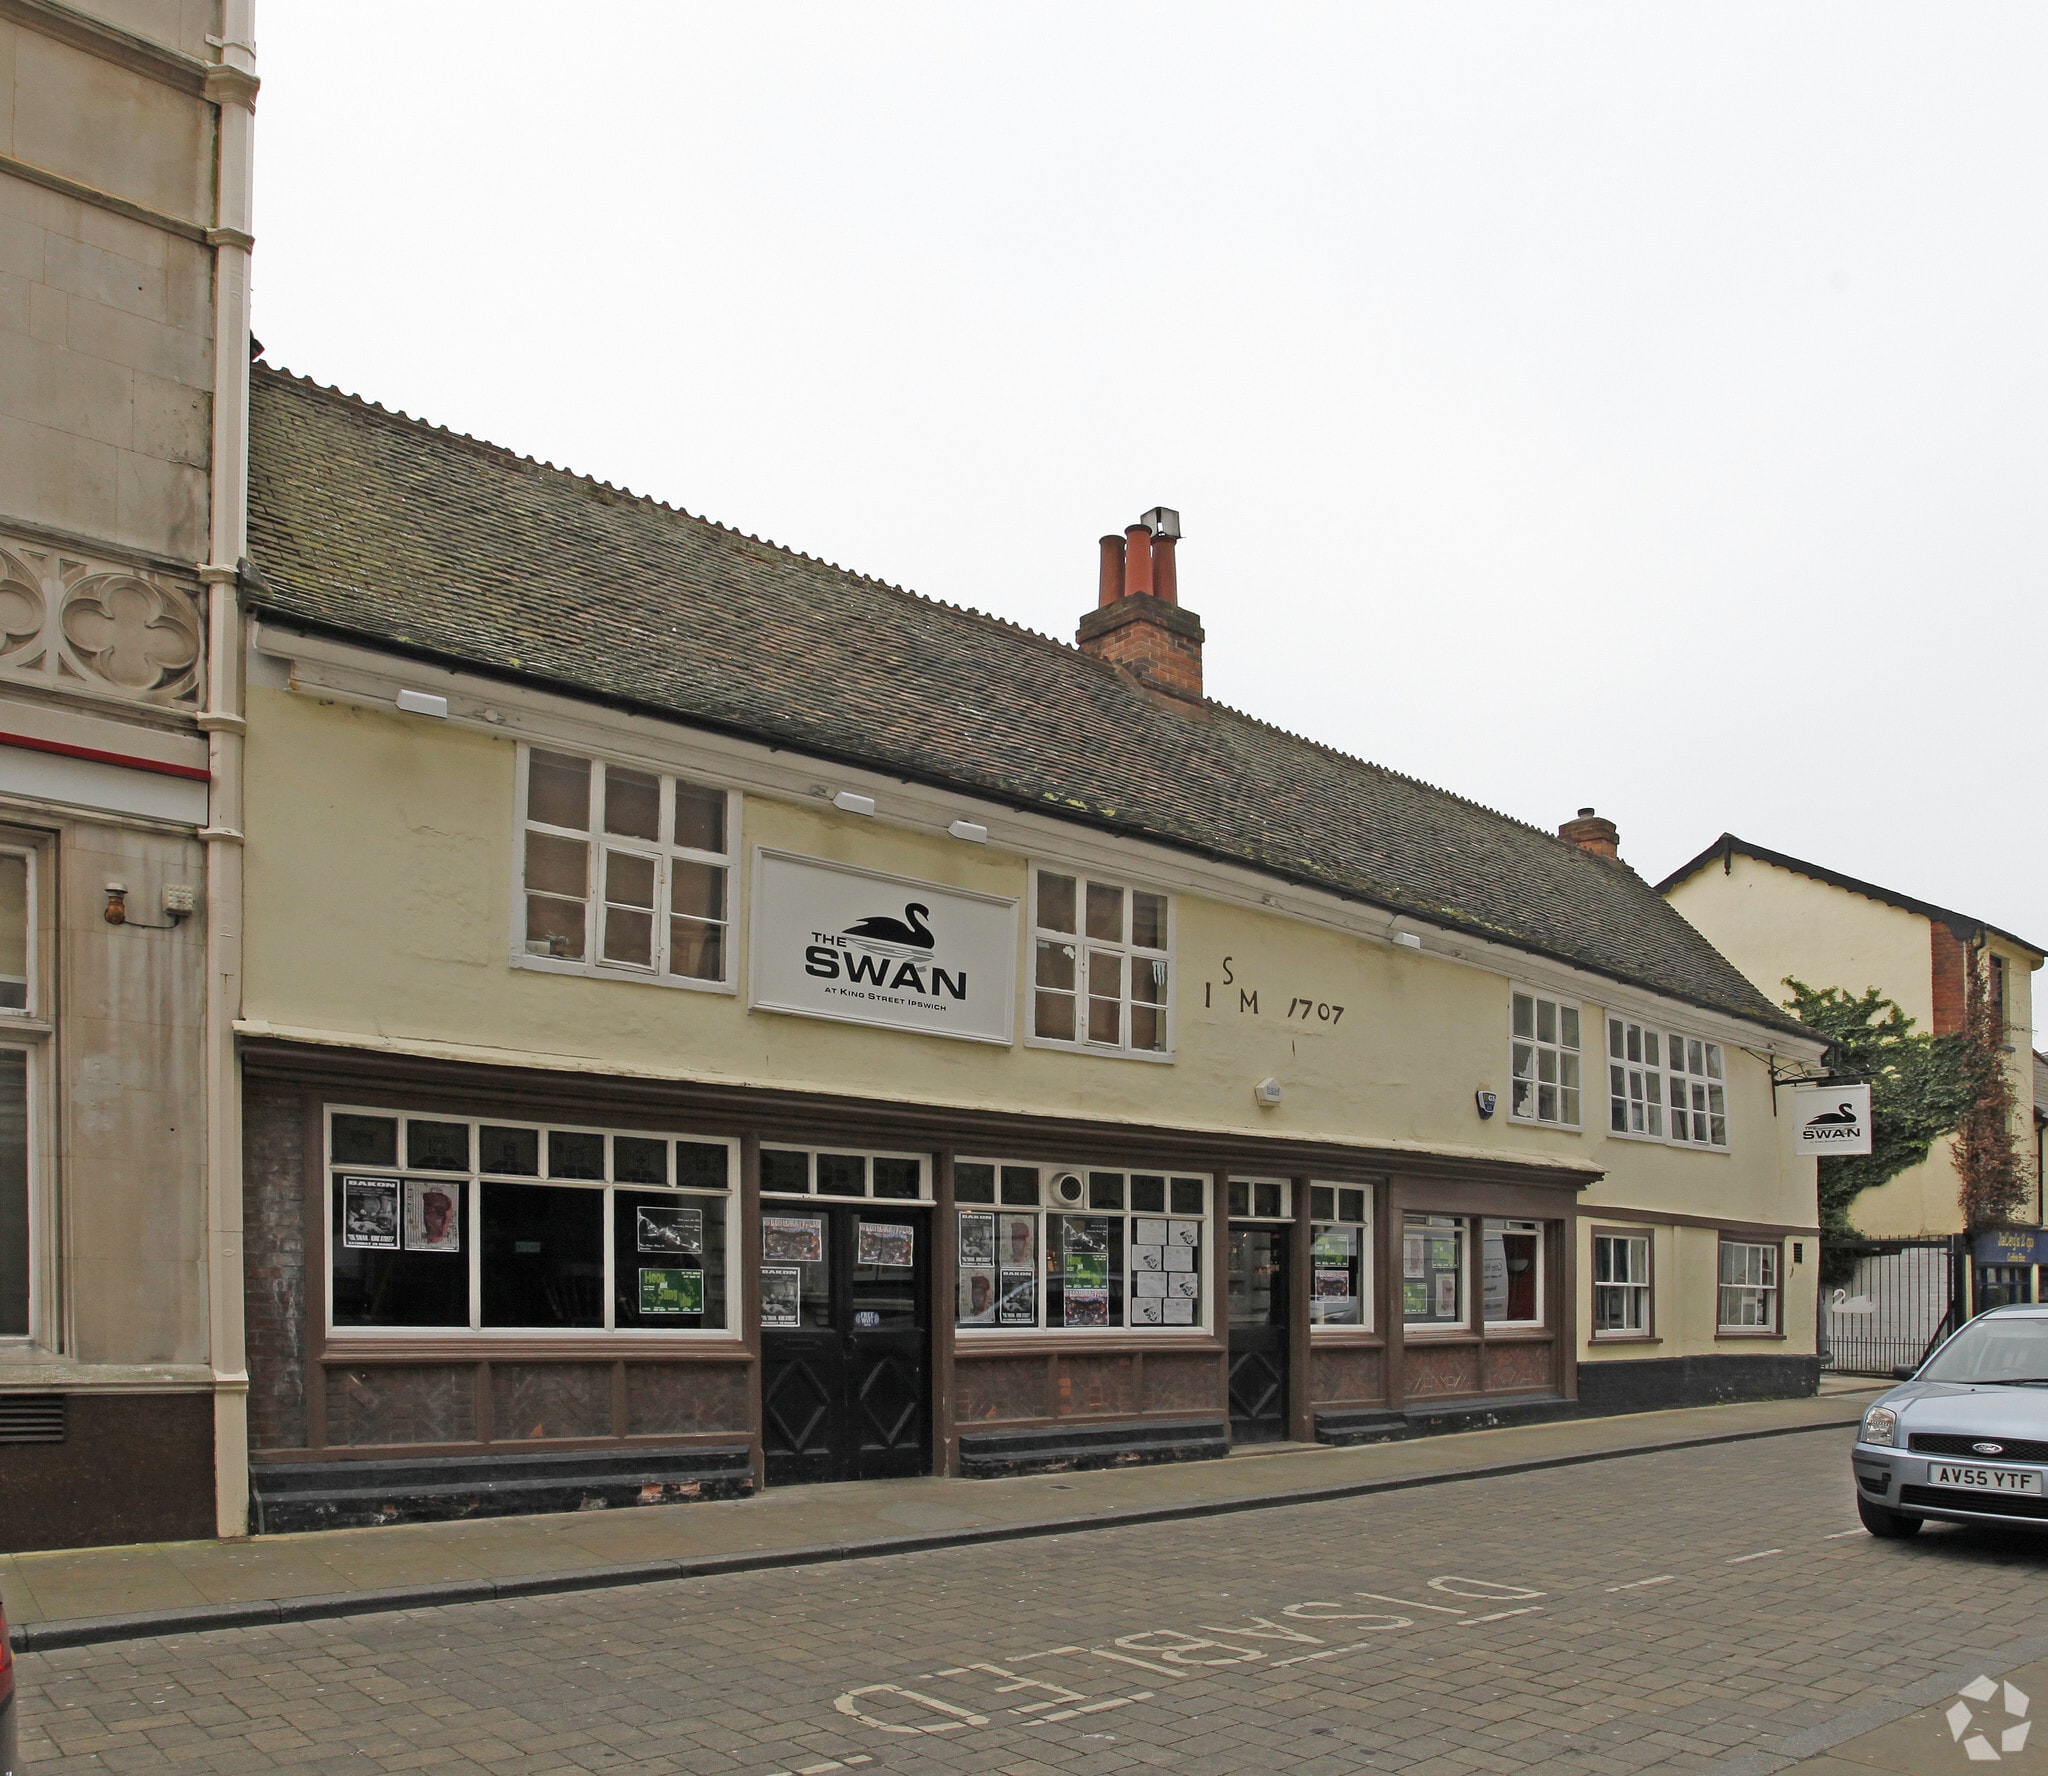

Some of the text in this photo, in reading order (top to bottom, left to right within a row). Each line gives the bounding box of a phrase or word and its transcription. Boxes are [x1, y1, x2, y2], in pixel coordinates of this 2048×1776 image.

[811, 932, 847, 948] THE
[805, 945, 967, 1000] SWAN
[1222, 956, 1234, 985] S
[840, 988, 864, 998] KING
[868, 992, 905, 1004] STREET
[908, 998, 946, 1011] IPSWICH
[1240, 988, 1258, 1014] M
[1288, 998, 1344, 1024] 1707
[1802, 1128, 1860, 1140] SWAN
[1940, 1468, 2032, 1488] AV55 YTF
[834, 1575, 1546, 1732] DISABLED
